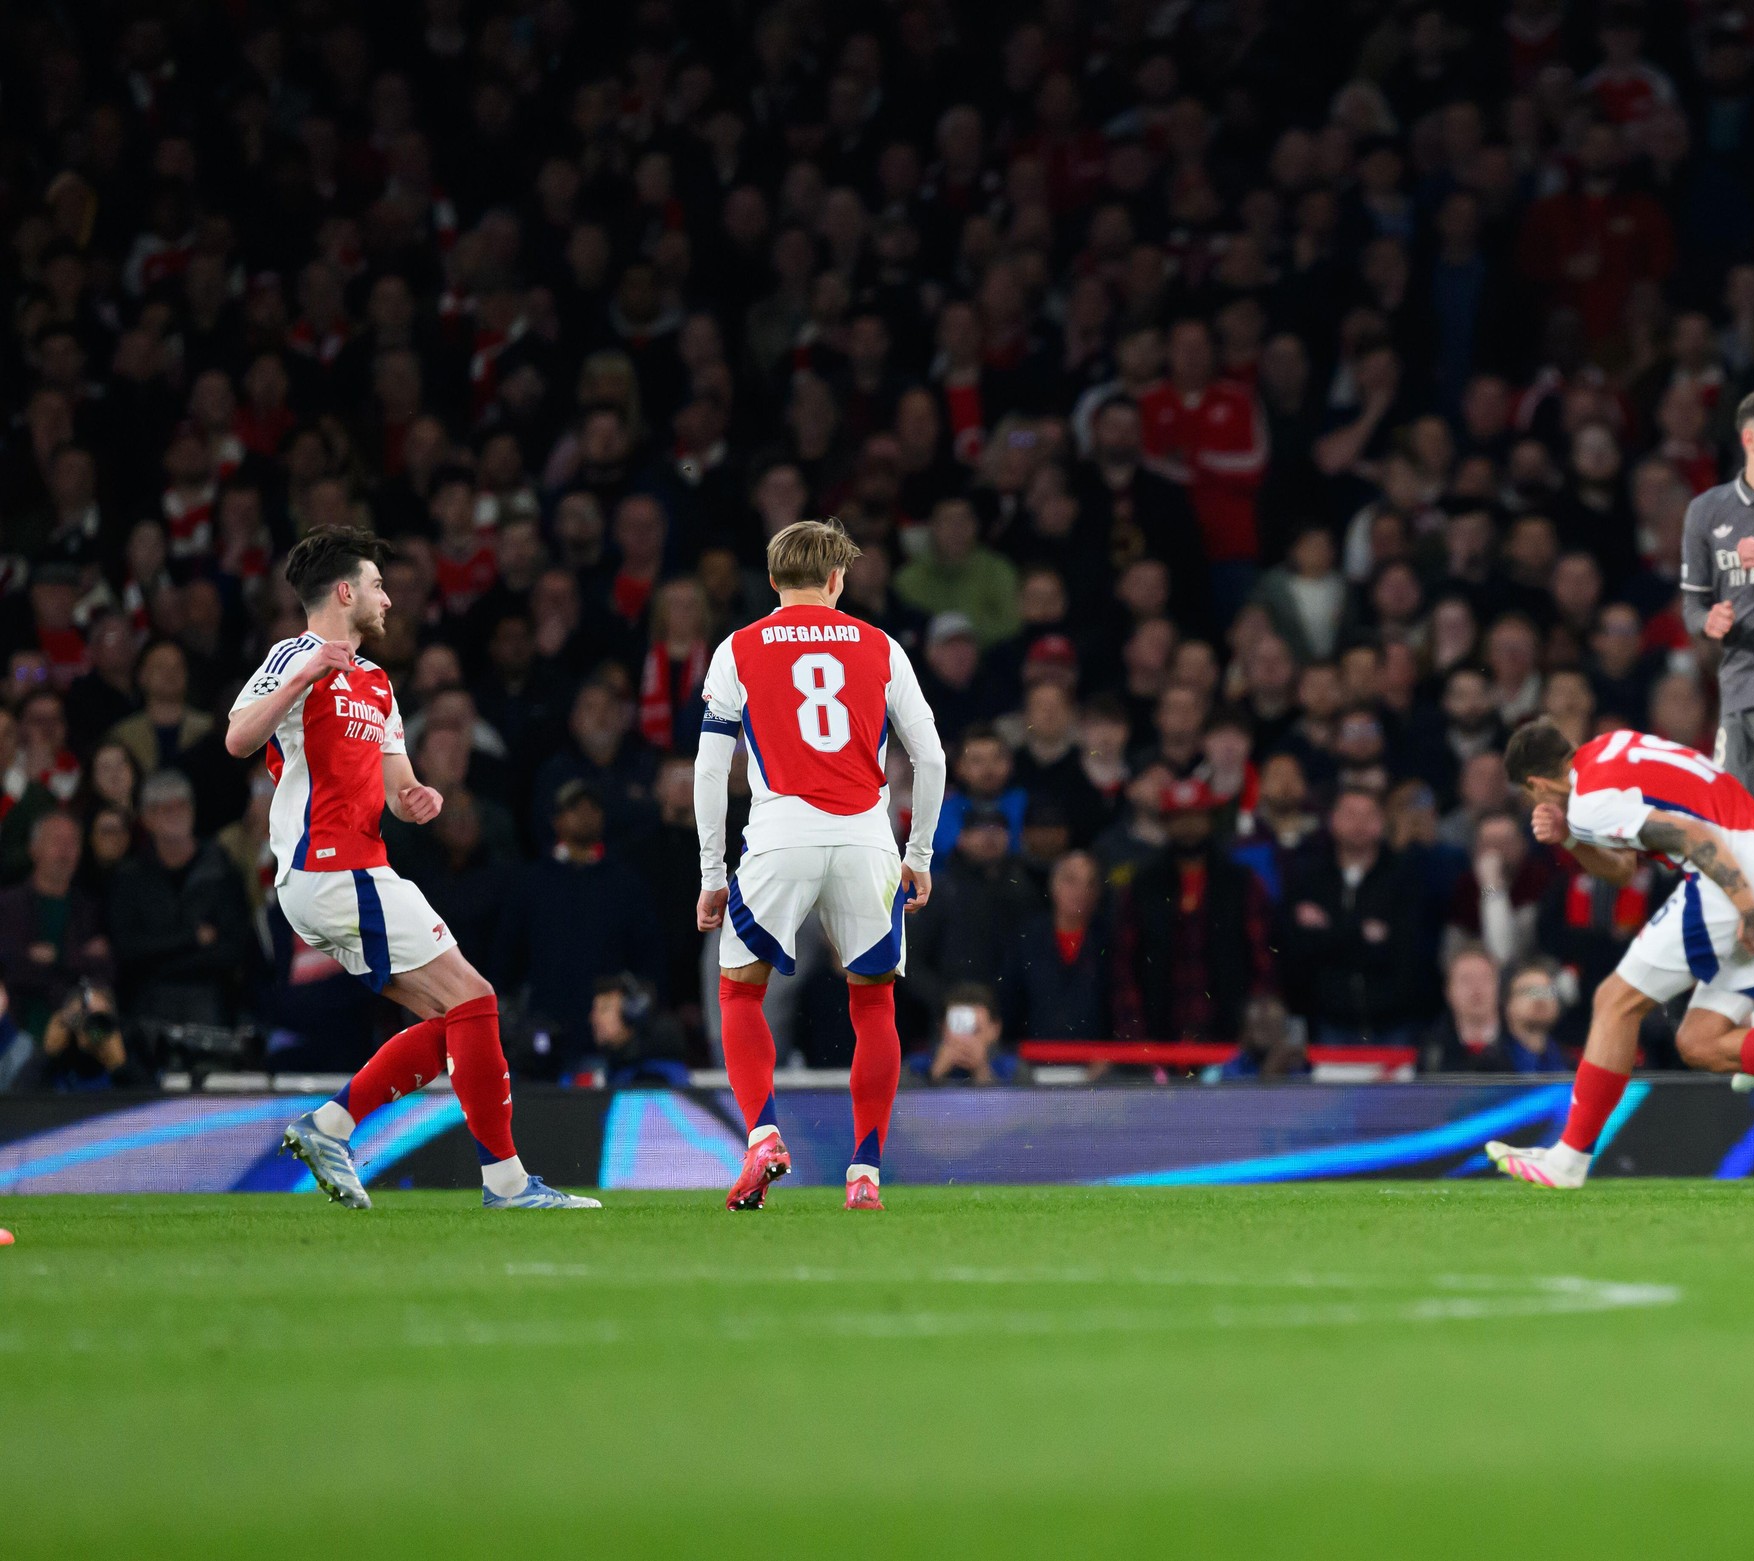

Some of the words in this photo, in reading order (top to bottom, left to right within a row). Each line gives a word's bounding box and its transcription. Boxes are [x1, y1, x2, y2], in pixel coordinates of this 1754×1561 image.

[761, 625, 861, 645] ØDEGAARD
[791, 652, 852, 753] 8
[344, 720, 364, 739] FLY
